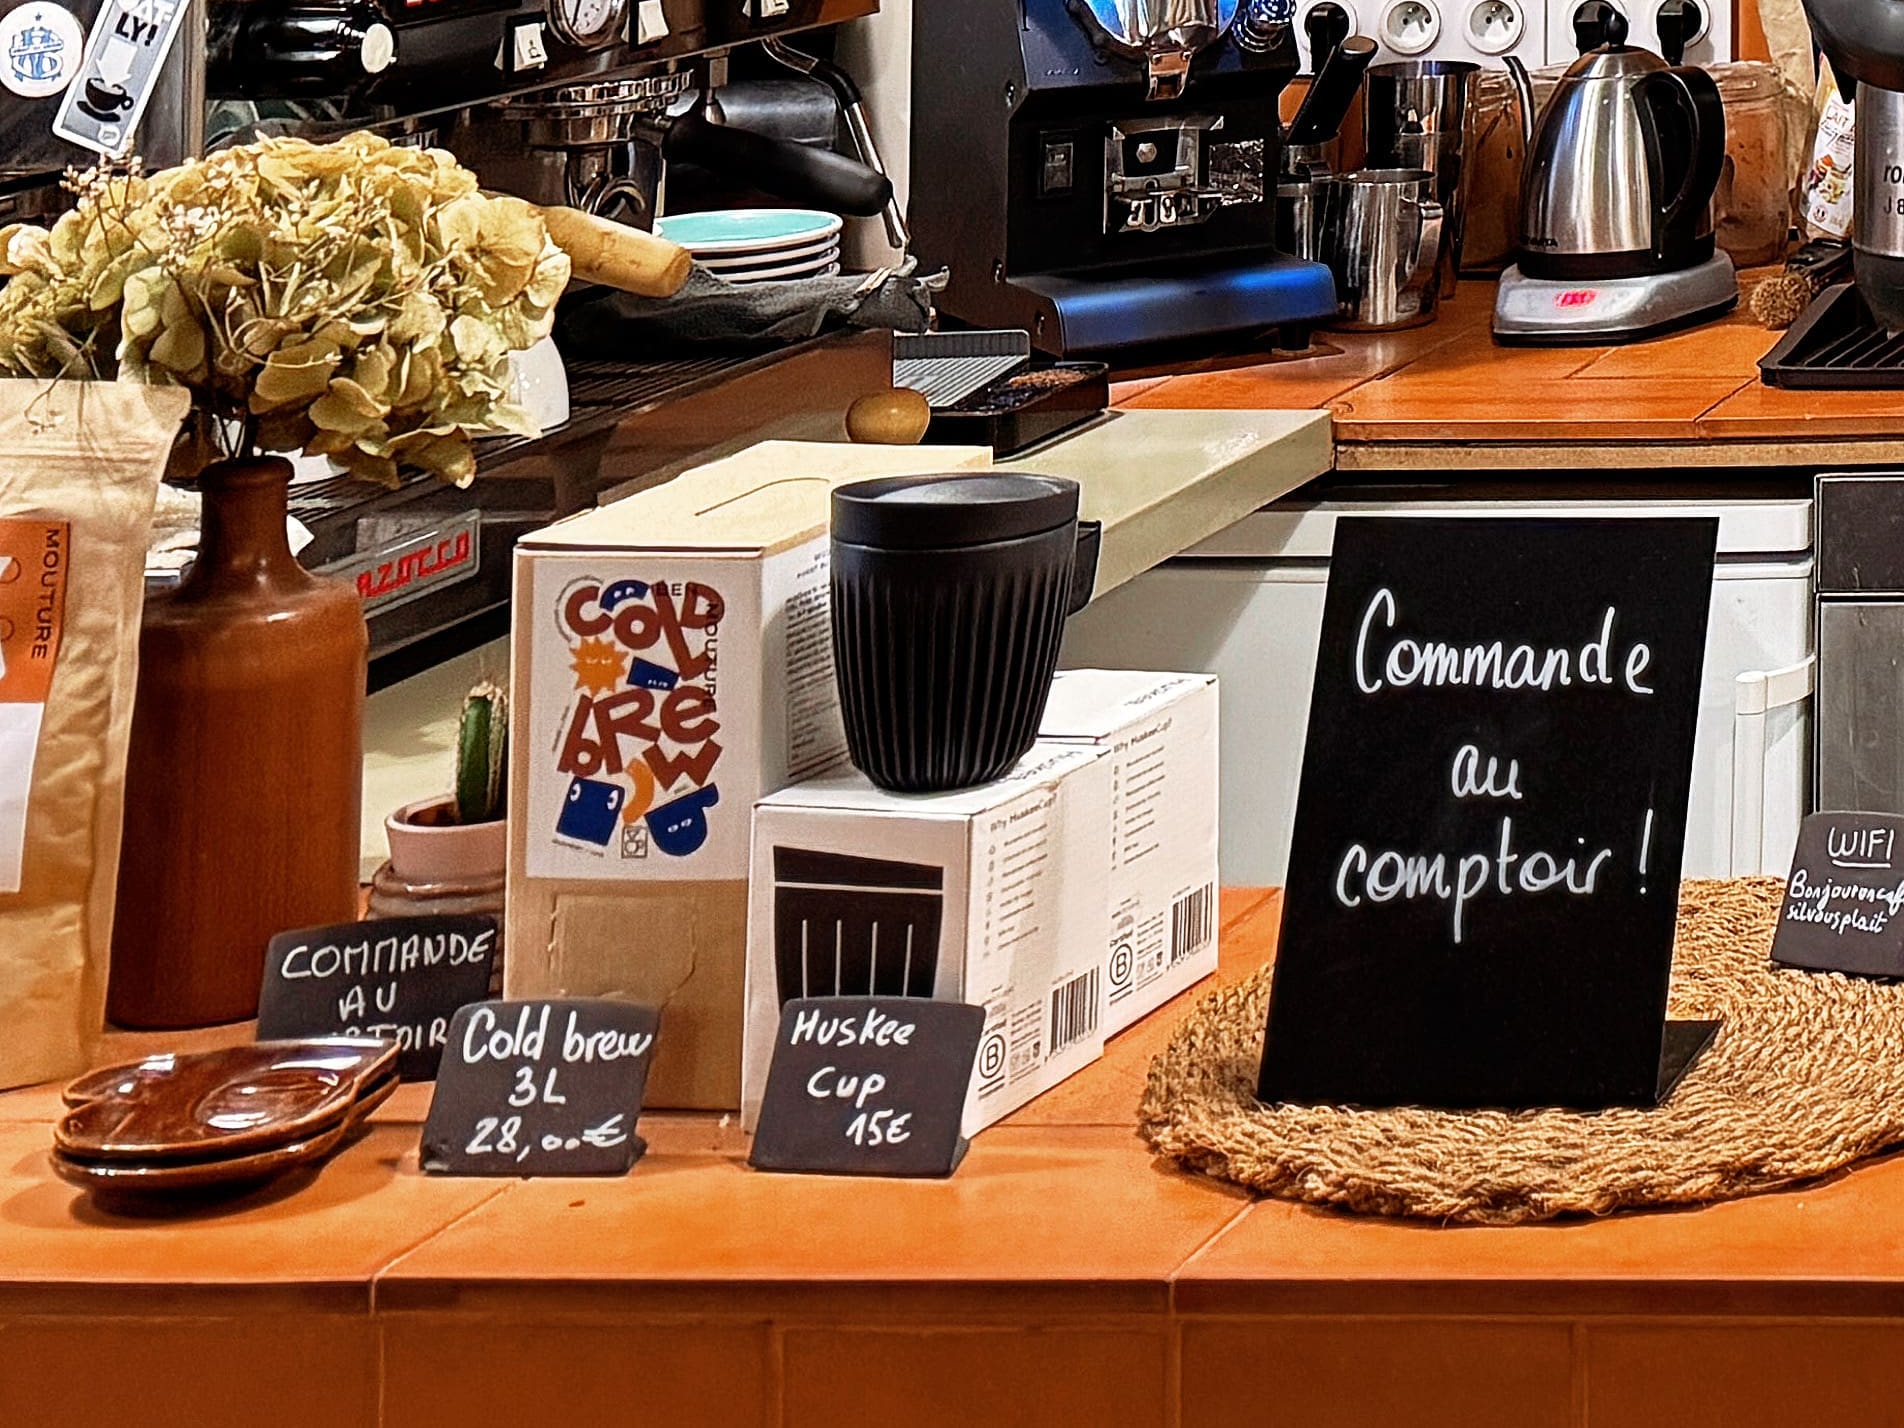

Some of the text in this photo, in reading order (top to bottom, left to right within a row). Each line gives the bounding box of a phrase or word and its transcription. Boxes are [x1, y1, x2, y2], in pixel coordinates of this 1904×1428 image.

[31, 529, 60, 659] MOUTURE
[1356, 588, 1654, 695] Commande
[1451, 744, 1523, 800] au
[1828, 827, 1895, 860] WIFI
[1336, 816, 1612, 944] comptoir
[281, 928, 495, 980] COMMANDE
[339, 982, 397, 1022] AU
[463, 1004, 653, 1065] Cold brew
[807, 1066, 887, 1109] Cup
[846, 1108, 913, 1147] 15€
